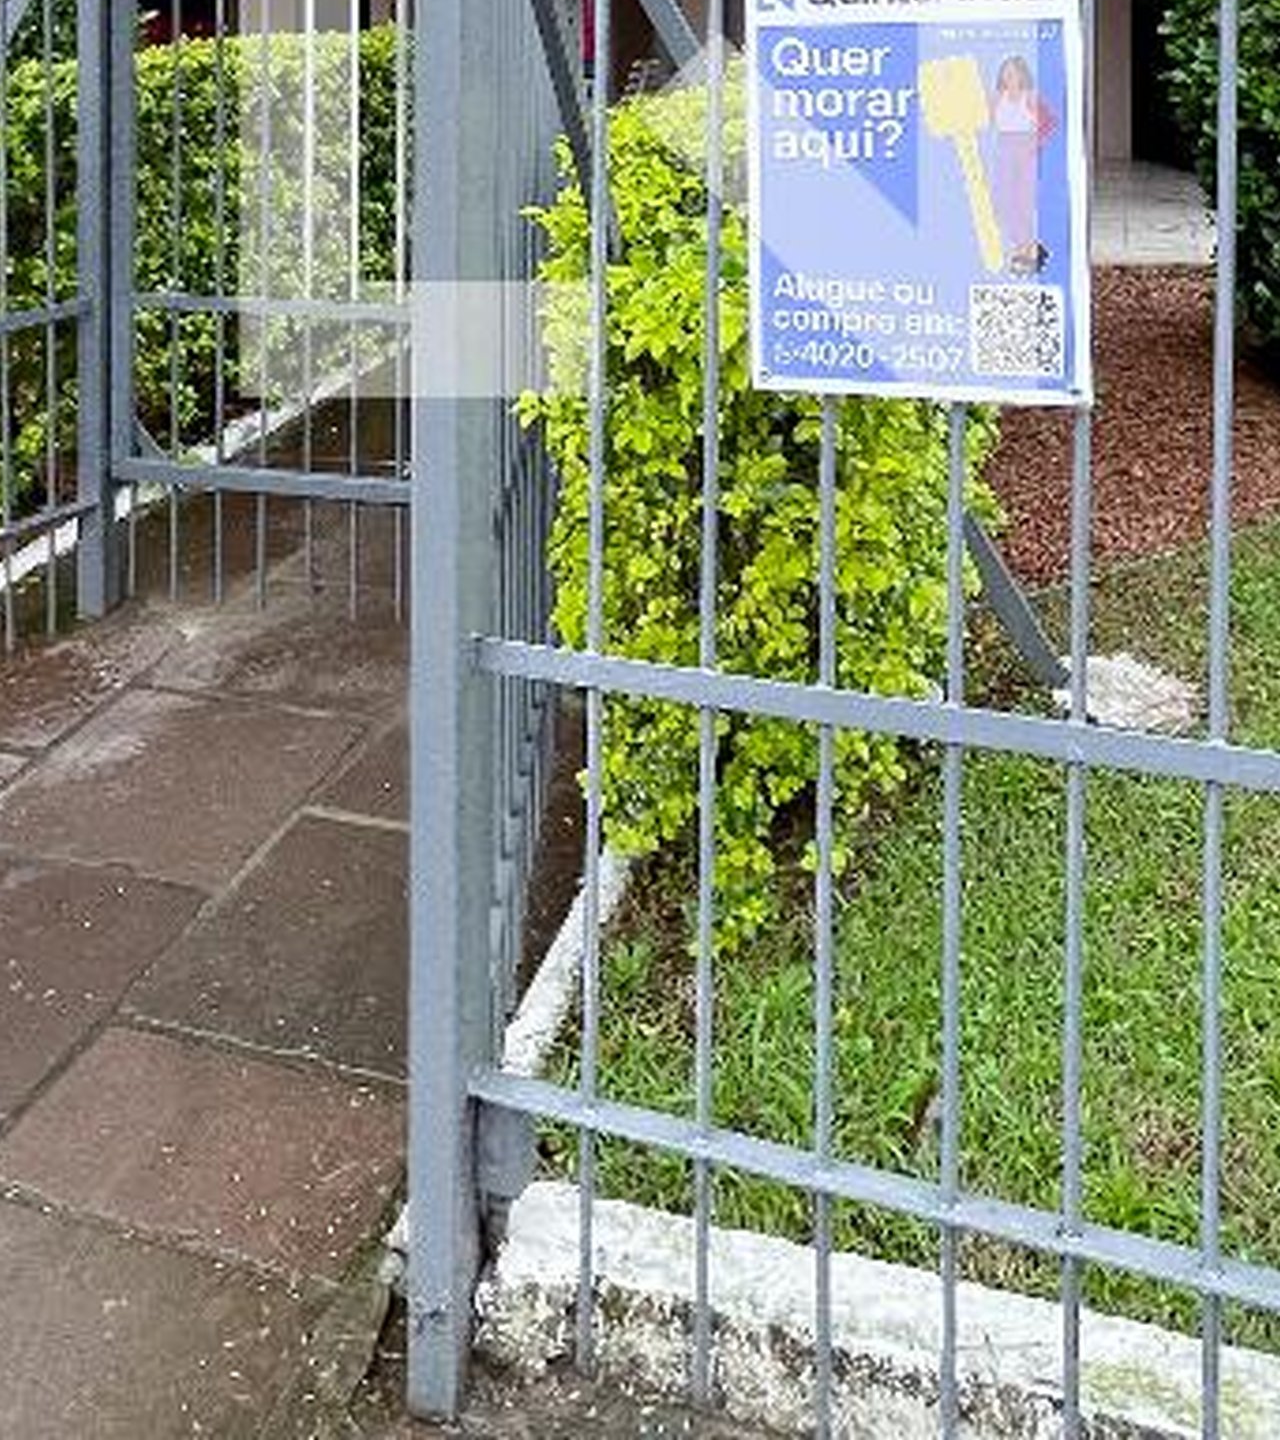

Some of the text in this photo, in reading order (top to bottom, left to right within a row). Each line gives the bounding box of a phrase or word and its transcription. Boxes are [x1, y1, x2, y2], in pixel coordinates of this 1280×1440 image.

[772, 36, 892, 77] Quer
[773, 87, 916, 118] morar
[773, 119, 904, 169] aqui?
[774, 273, 935, 307] Alugue ou
[773, 309, 897, 336] compra
